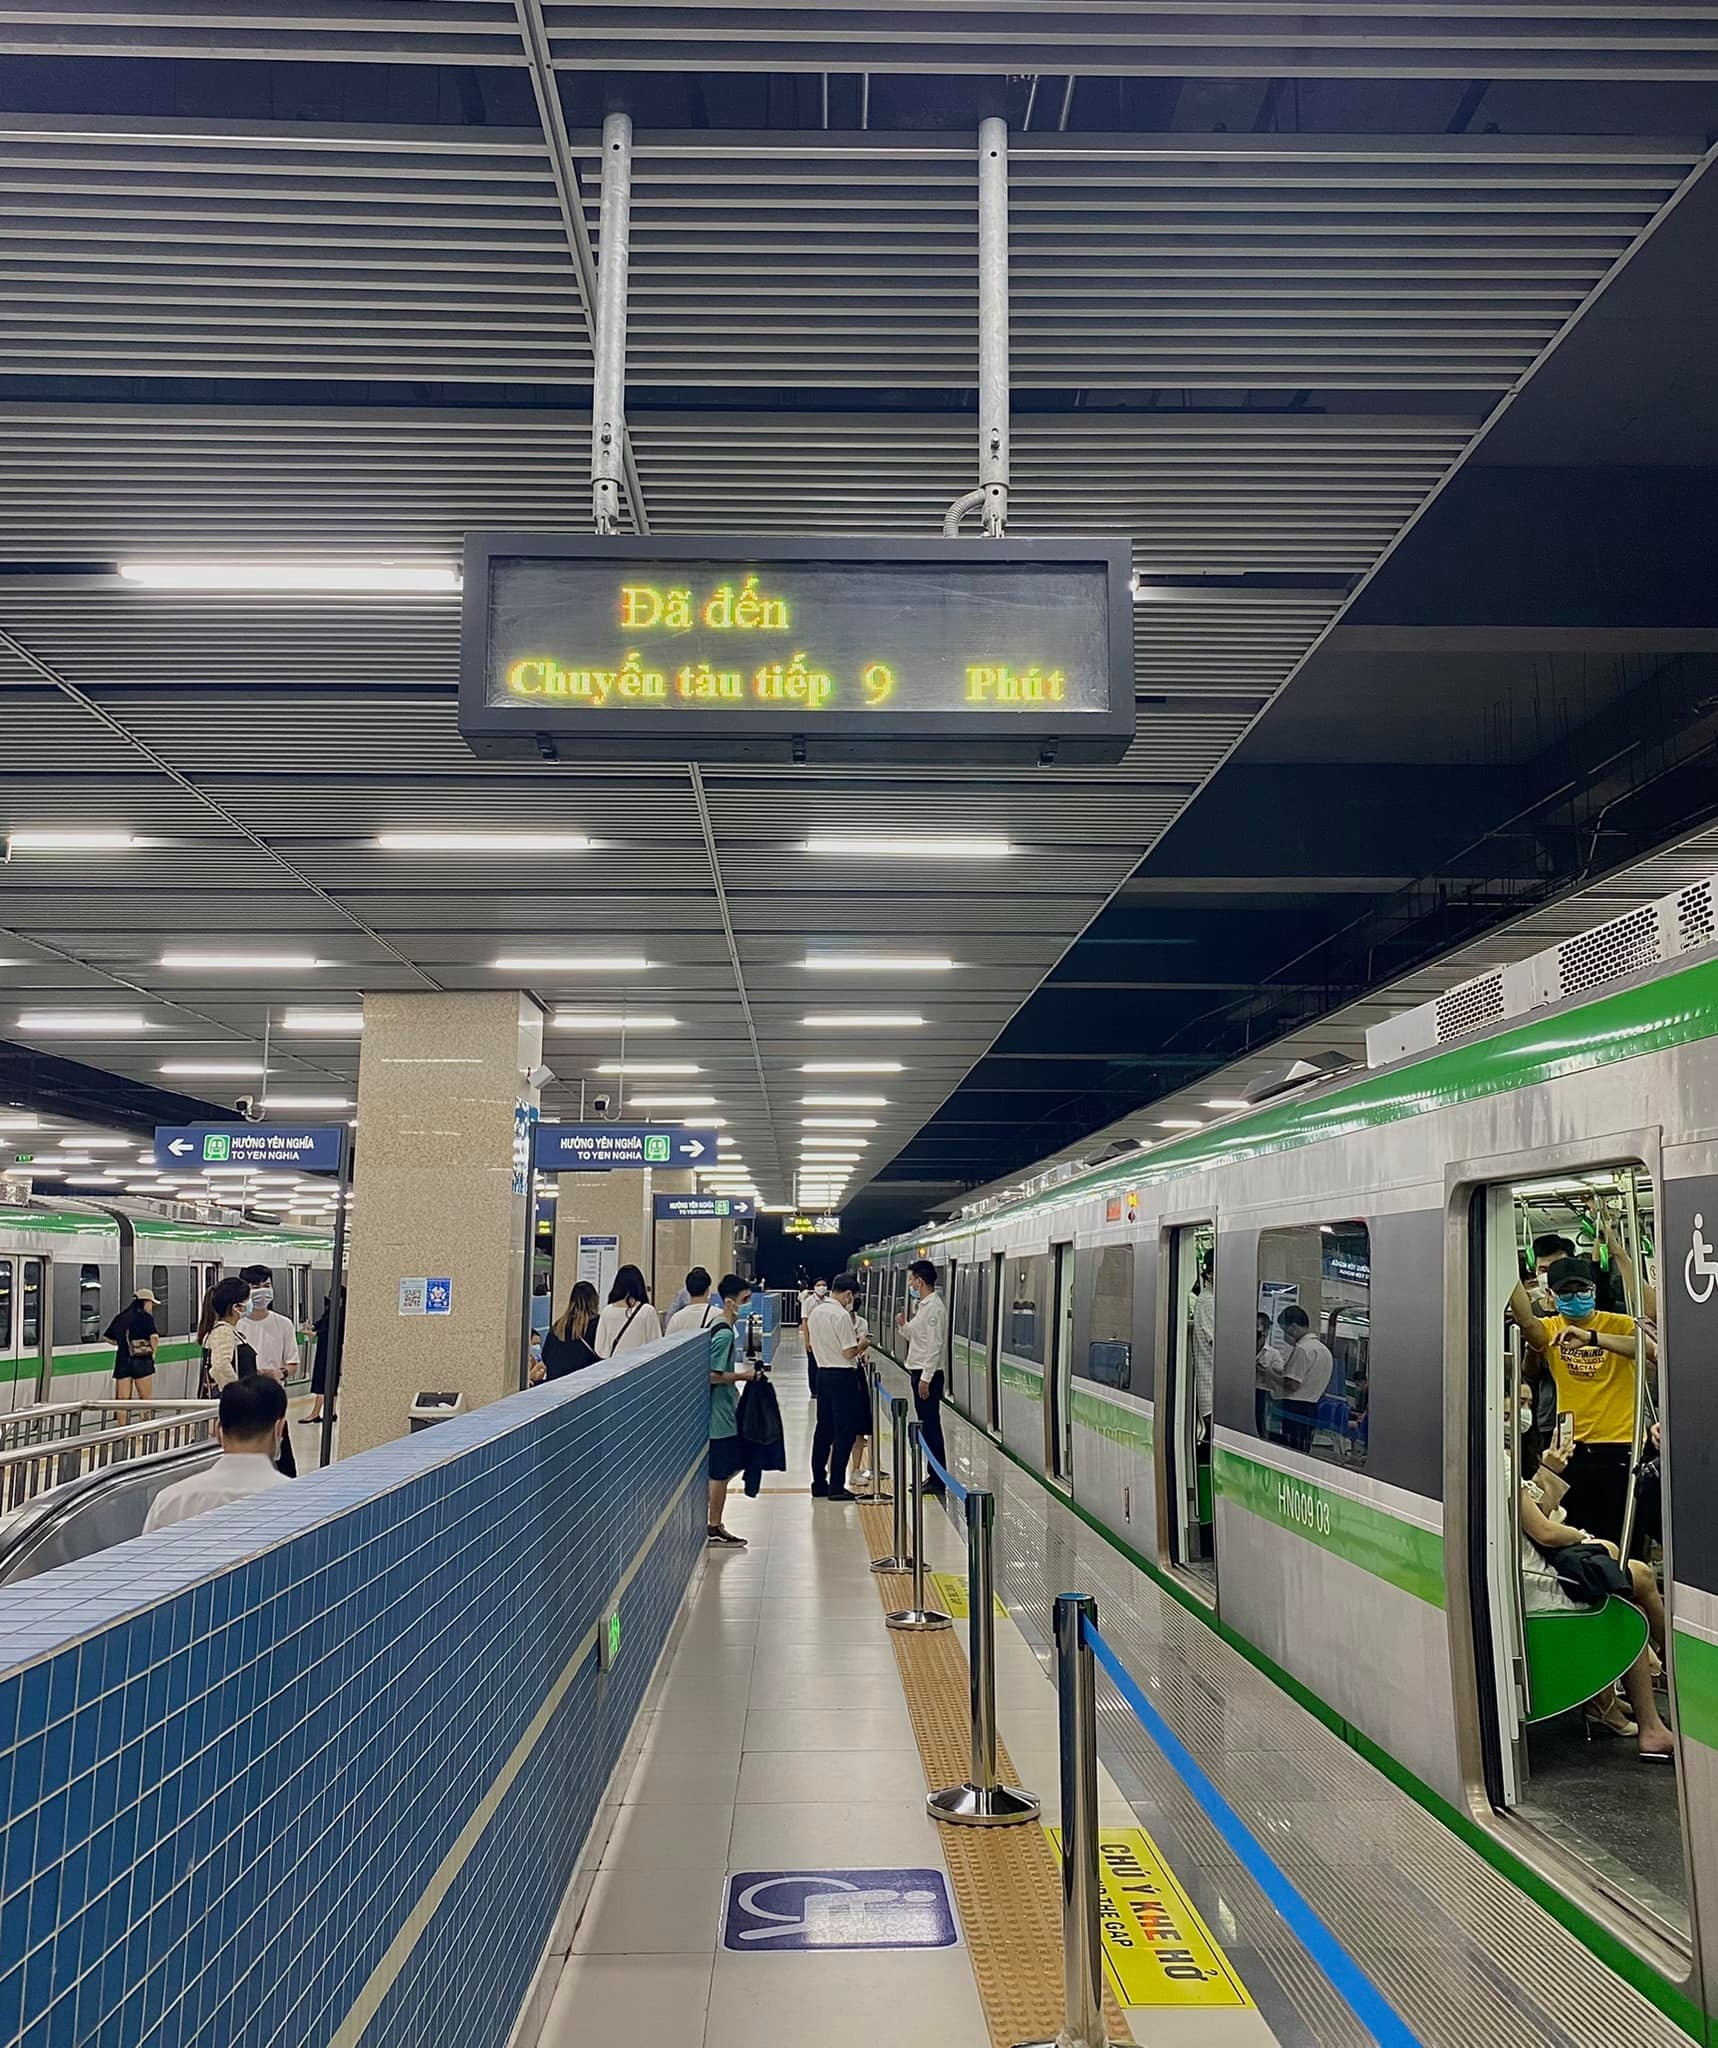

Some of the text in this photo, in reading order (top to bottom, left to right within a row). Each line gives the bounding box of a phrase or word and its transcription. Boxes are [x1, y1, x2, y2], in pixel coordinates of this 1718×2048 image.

[621, 576, 790, 630] Đã đến
[511, 653, 1066, 704] Chuyến tàu tiếp 9 Phút
[231, 1135, 314, 1149] HƯỚNG YÊN NGHĨA
[231, 1151, 300, 1160] TO YEN NGHIA
[560, 1136, 643, 1149] HƯỚNG YÊN NGHĨA
[577, 1151, 643, 1160] TO YEN NGHIA
[1278, 1481, 1331, 1536] HN009 03
[1100, 1843, 1218, 1982] CHÚ Ý KHE HỞ
[1100, 1897, 1133, 1948] THE GAP
